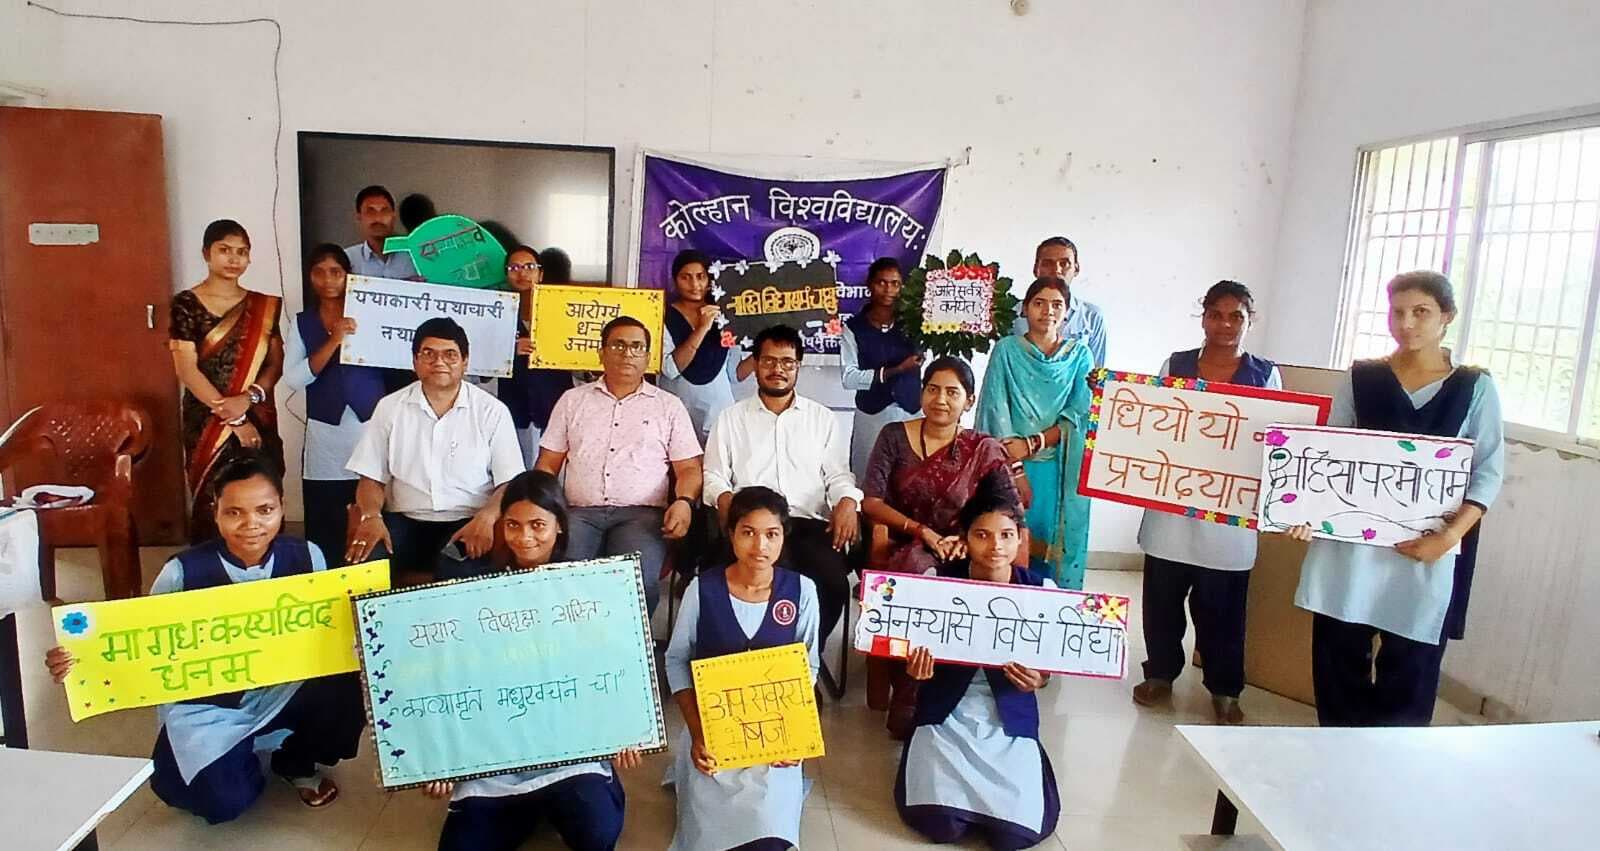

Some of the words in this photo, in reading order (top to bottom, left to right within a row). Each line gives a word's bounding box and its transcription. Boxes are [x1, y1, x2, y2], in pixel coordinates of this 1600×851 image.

[659, 194, 751, 240] कोल्हान
[768, 187, 926, 250] विश्वविद्यालयः
[565, 299, 621, 319] आरोग्यं
[1107, 387, 1194, 443] धियो
[1198, 401, 1249, 451] यो
[101, 627, 143, 662] मा
[865, 596, 979, 647] अनभ्यासे
[985, 596, 1050, 655] विषं
[1056, 605, 1124, 663] विद्या
[152, 650, 263, 692] धनम्
[401, 685, 483, 721] काव्यामृतं
